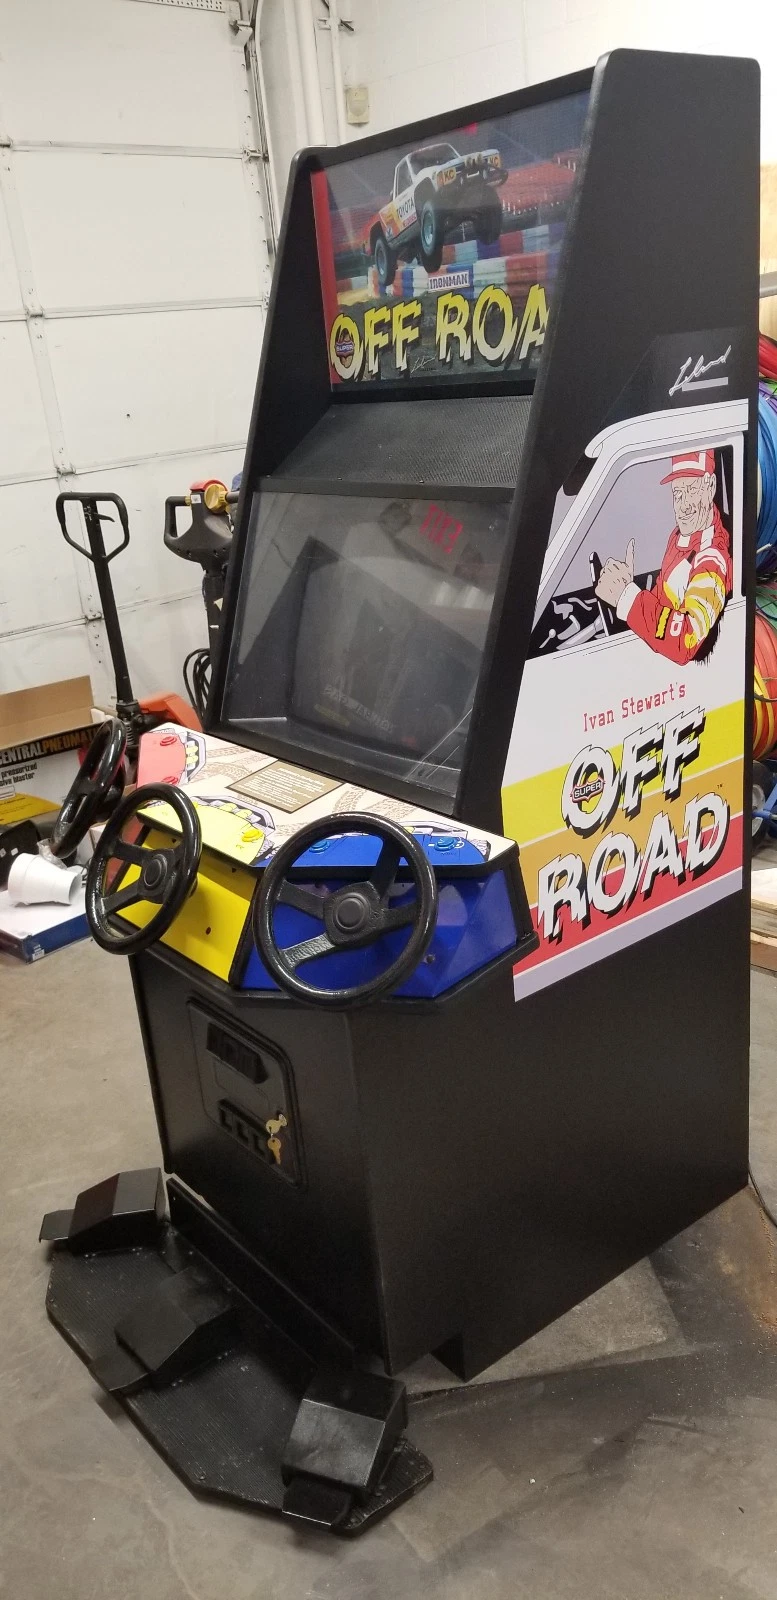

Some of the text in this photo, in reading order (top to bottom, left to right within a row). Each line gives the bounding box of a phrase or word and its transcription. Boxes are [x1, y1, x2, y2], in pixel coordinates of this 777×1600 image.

[396, 197, 415, 219] TOYOTA
[429, 273, 468, 290] IRONMAN
[329, 300, 422, 381] OFF
[335, 343, 354, 352] SUPER
[583, 683, 686, 732] Ivan Stewart's
[1, 762, 38, 780] pressurized
[13, 772, 35, 783] blaster
[561, 705, 706, 838] OFF
[574, 781, 601, 798] SUPER
[537, 791, 731, 946] ROAD
